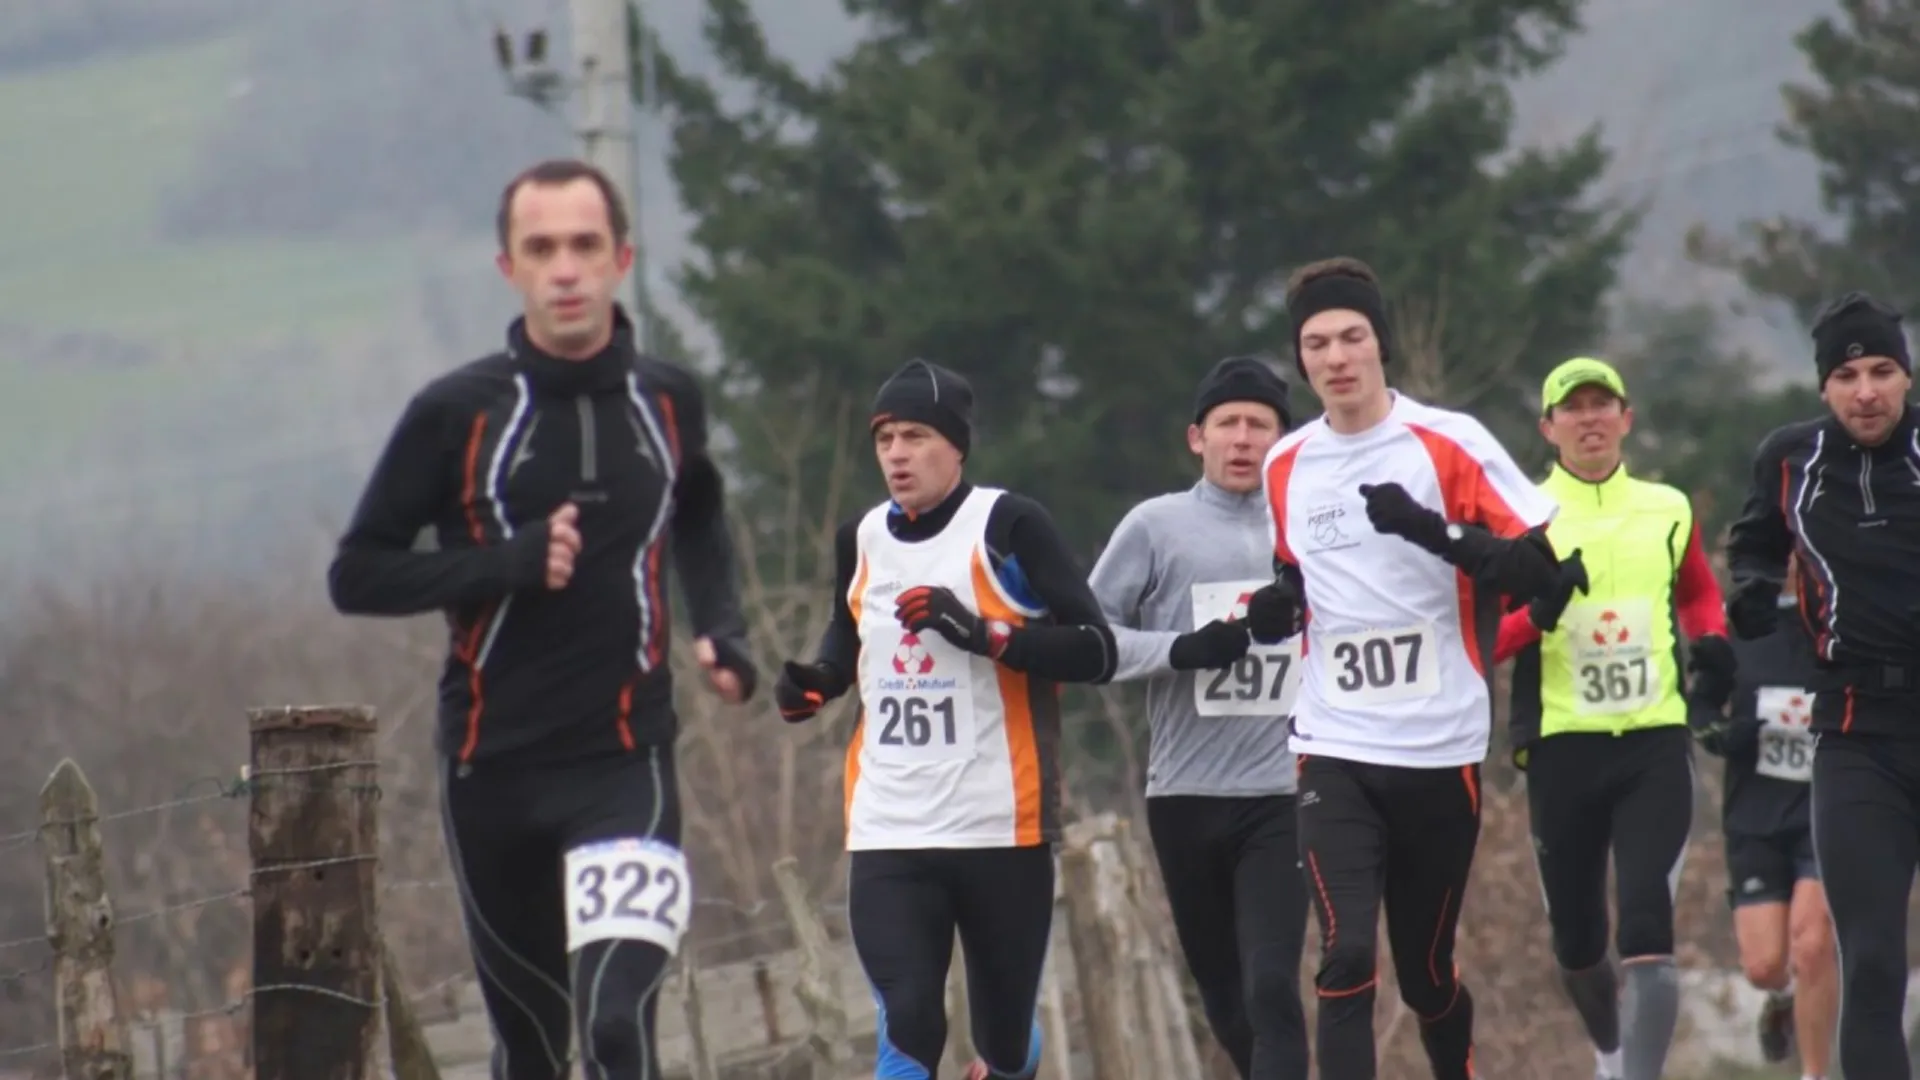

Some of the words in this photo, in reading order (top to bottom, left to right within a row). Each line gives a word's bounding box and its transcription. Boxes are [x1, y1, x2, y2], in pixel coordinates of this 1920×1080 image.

[1204, 653, 1291, 701] 297
[1334, 633, 1422, 692] 307
[1581, 658, 1647, 703] 367
[879, 696, 956, 746] 261
[1764, 734, 1813, 769] 36
[577, 861, 680, 931] 322
